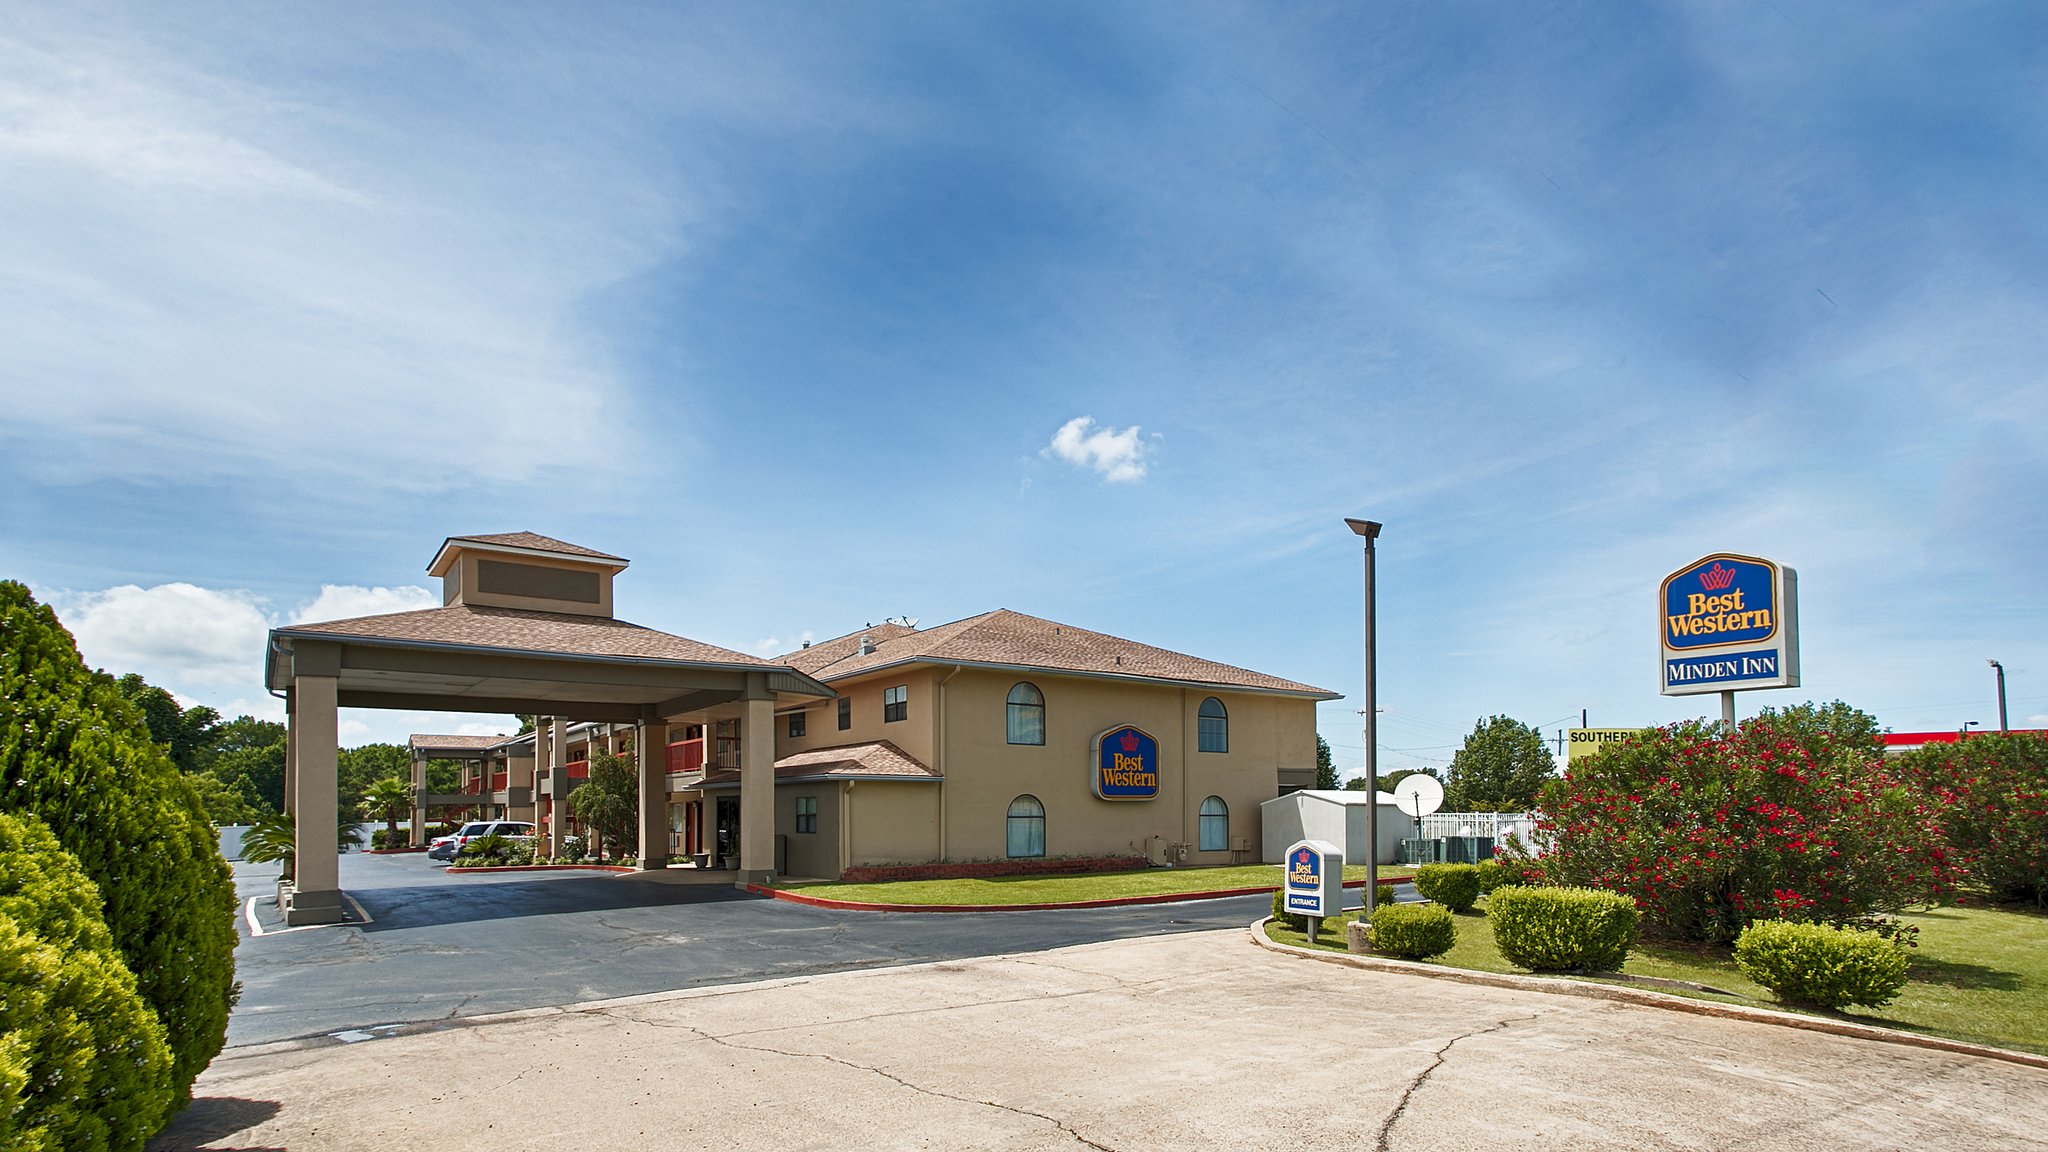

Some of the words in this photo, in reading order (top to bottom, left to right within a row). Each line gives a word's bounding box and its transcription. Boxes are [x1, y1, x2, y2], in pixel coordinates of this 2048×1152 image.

[1688, 588, 1744, 615] Best
[1668, 609, 1772, 637] Western
[1669, 661, 1737, 681] MINDEN
[1742, 657, 1775, 675] INN
[1113, 753, 1143, 771] Best
[1103, 768, 1156, 786] Western
[1296, 862, 1312, 874] Best
[1290, 872, 1319, 884] Western
[1291, 898, 1317, 906] ENTRANCE
